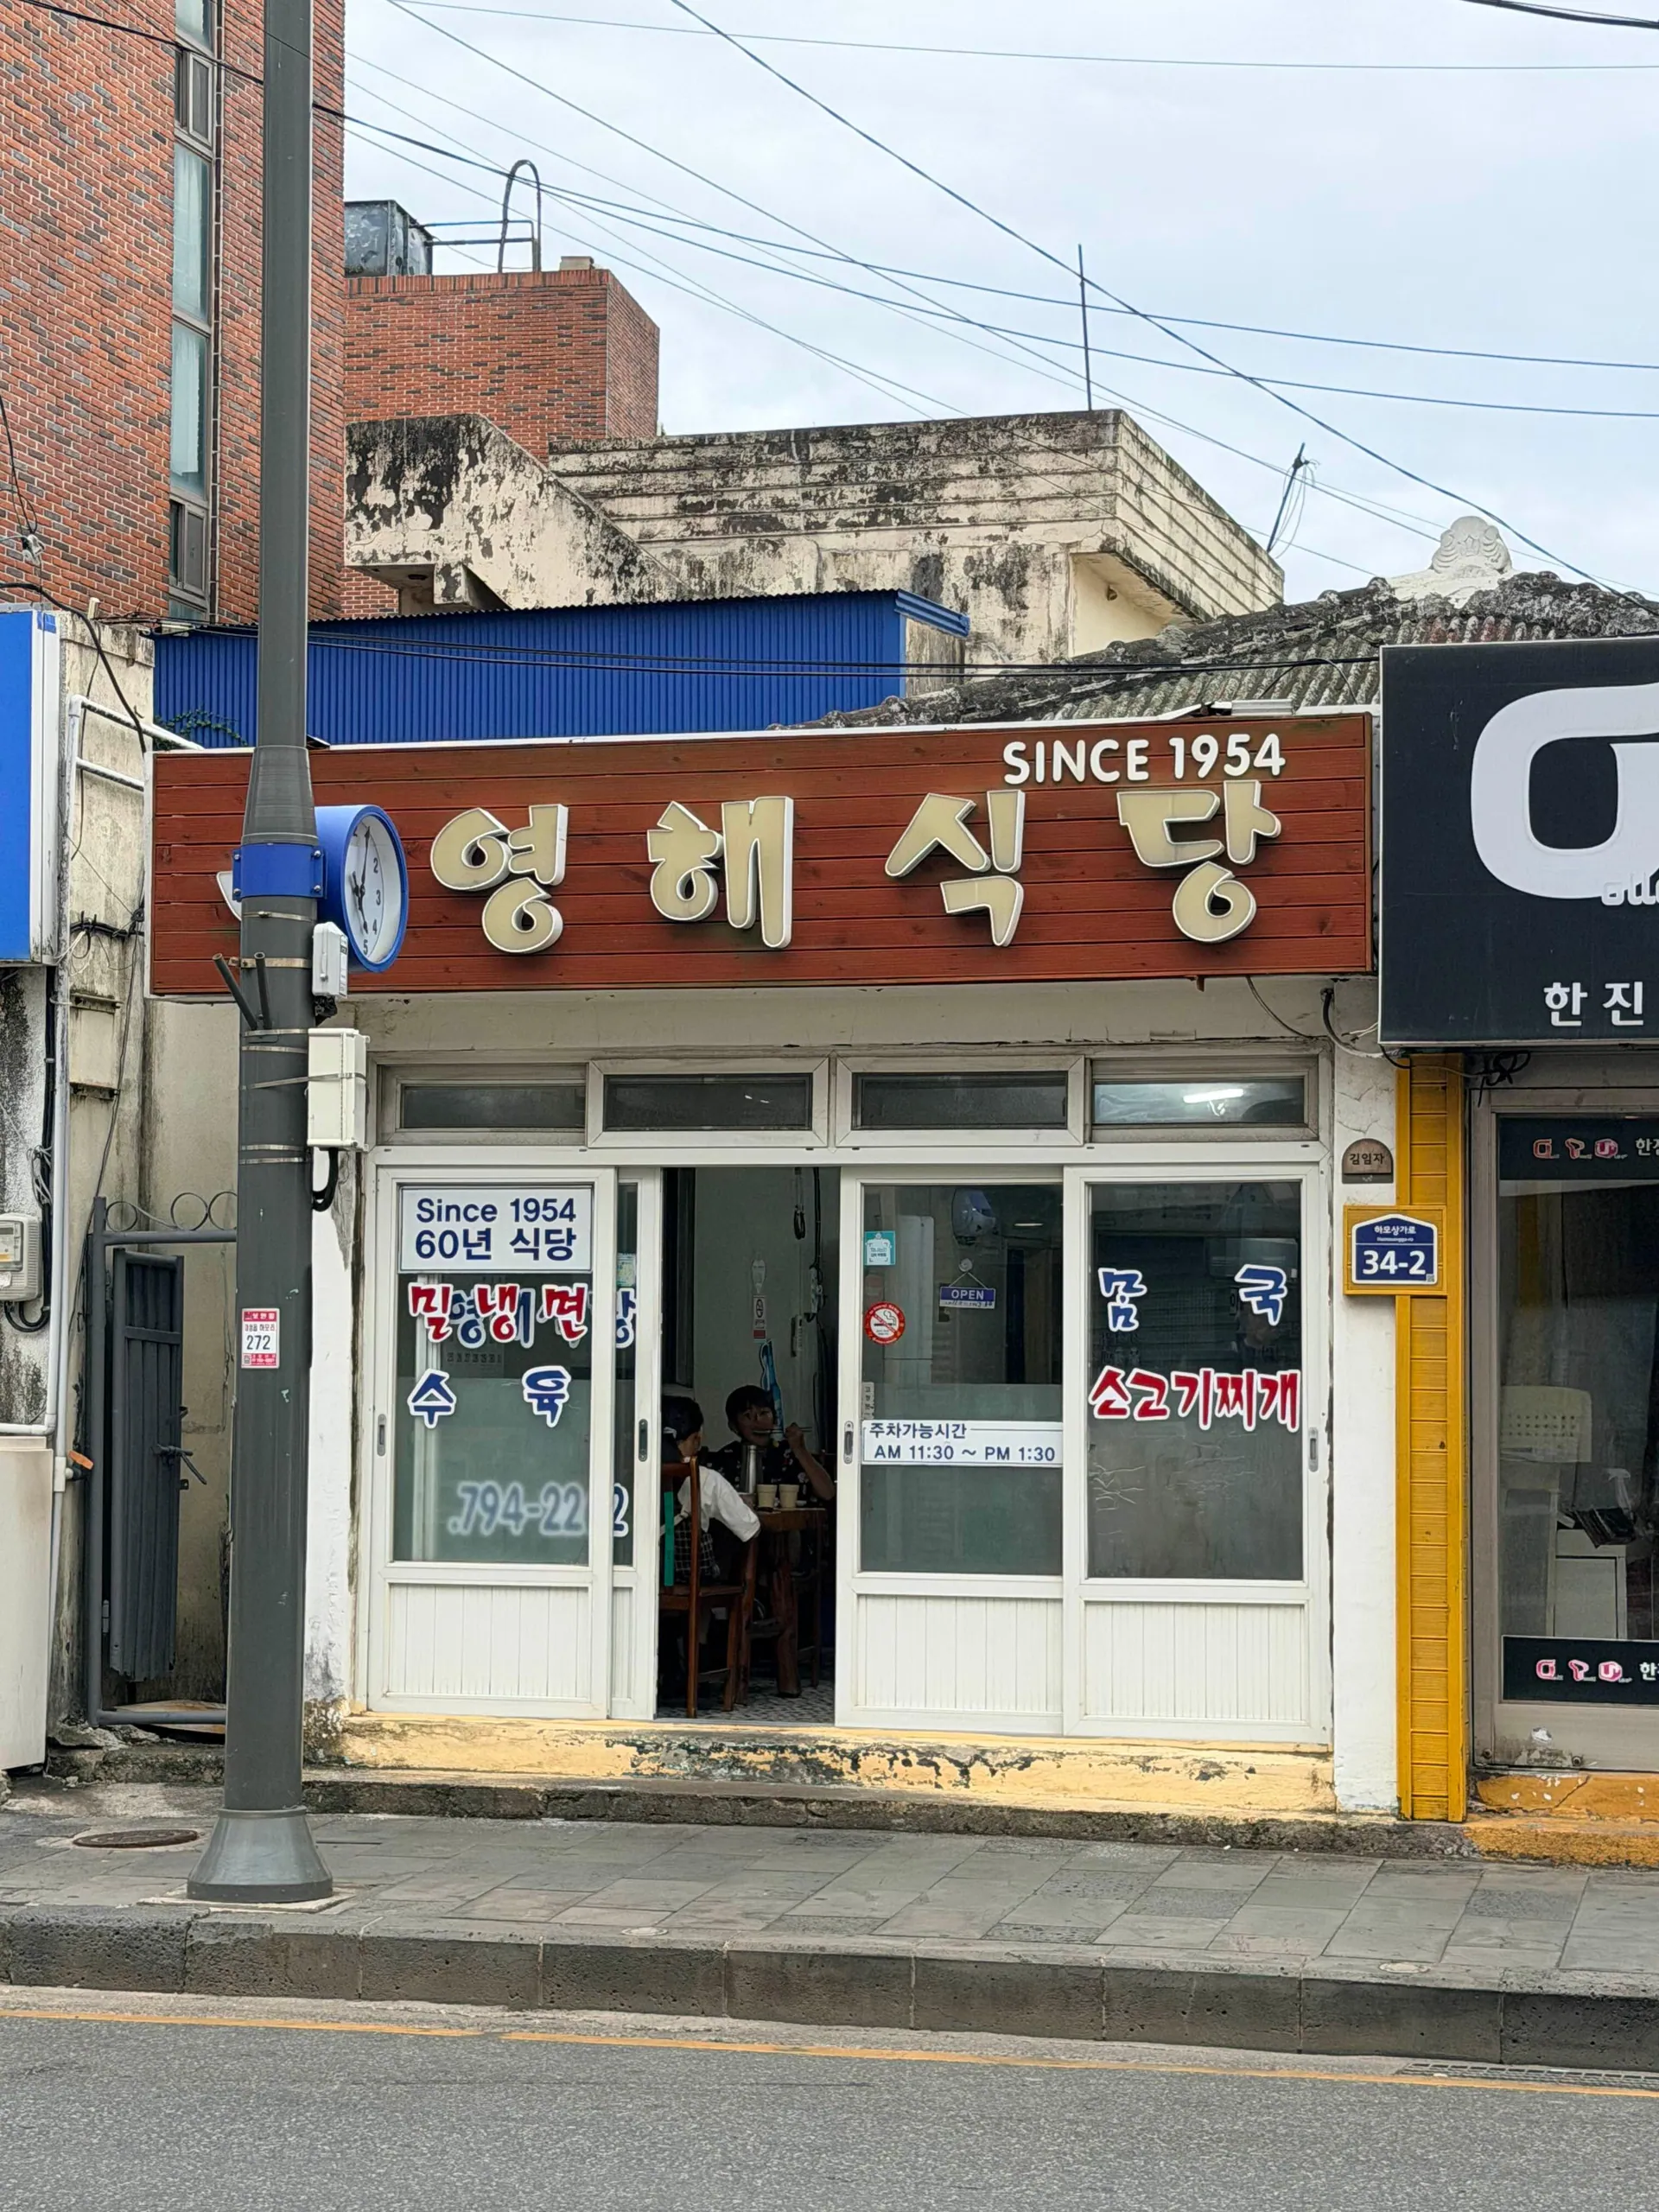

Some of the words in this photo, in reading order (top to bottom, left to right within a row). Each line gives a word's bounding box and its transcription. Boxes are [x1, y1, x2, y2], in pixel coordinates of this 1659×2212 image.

[1003, 739, 1149, 785] SINCE
[1168, 734, 1286, 779] 1954
[373, 859, 378, 874] 2
[376, 890, 381, 906] 3
[372, 919, 378, 934] 4
[1350, 1153, 1384, 1165] 김임자
[416, 1198, 498, 1223] Since
[510, 1198, 576, 1222] 1954
[1374, 1225, 1416, 1236] 하모상가로
[415, 1228, 492, 1261] 60년
[509, 1228, 576, 1262] 식당
[1363, 1250, 1426, 1274] 34-2
[951, 1289, 984, 1300] OPEN
[247, 1335, 270, 1350] 272
[1089, 1365, 1301, 1432] 소고기찌개
[869, 1422, 967, 1439] 주차가능시간
[874, 1446, 901, 1459] AM
[909, 1446, 954, 1459] 11:30
[984, 1446, 1010, 1460] PM
[1018, 1446, 1055, 1461] 1:30
